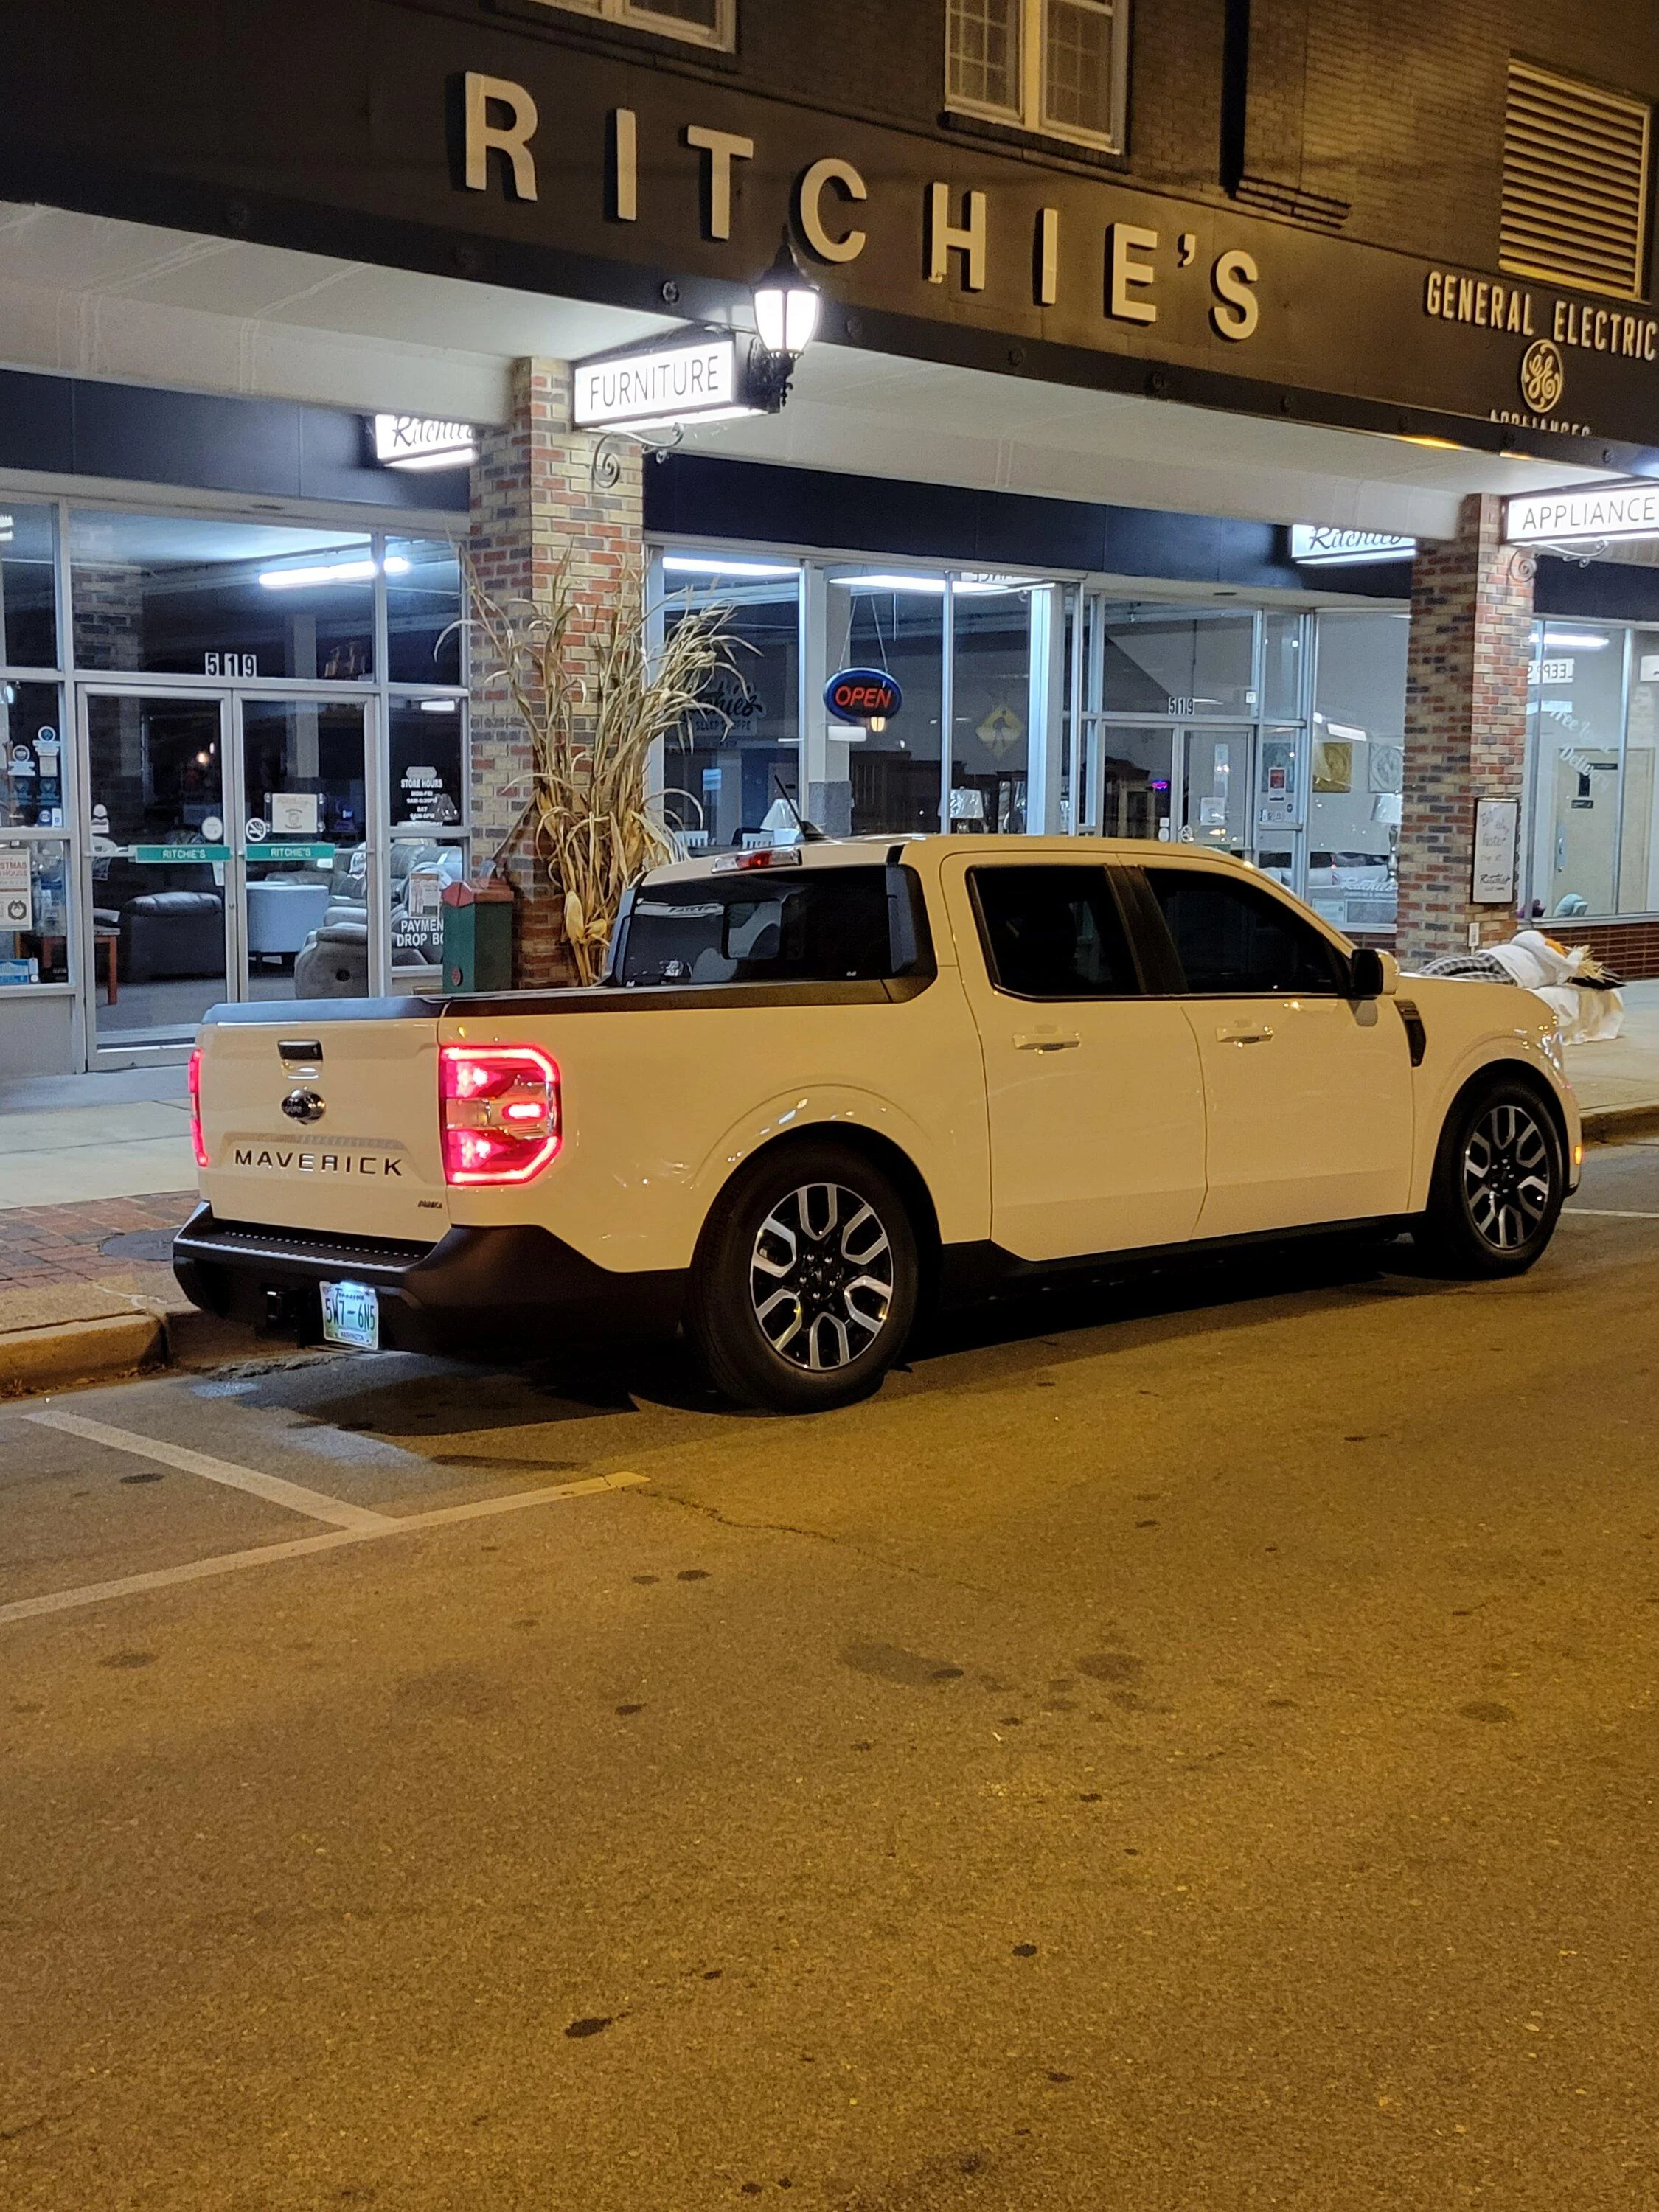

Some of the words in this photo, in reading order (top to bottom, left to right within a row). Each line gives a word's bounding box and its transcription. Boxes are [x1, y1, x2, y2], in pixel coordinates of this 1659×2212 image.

[465, 71, 1259, 340] RITCHIE'S
[1427, 271, 1534, 336] GENERAL
[1554, 300, 1657, 361] ELECTRIC
[591, 355, 719, 410] FURNITURE
[1522, 497, 1655, 530] APPLIANCE
[207, 653, 255, 678] 519
[835, 685, 892, 708] OPEN
[1169, 698, 1194, 714] 519
[400, 779, 420, 788] STORE
[422, 779, 442, 788] HOURS
[162, 849, 206, 859] RITCHIE'S
[271, 848, 311, 857] RITCHIE'S
[400, 919, 444, 933] PAYMEN
[397, 933, 428, 947] DROP
[234, 1149, 403, 1177] MAVERICK
